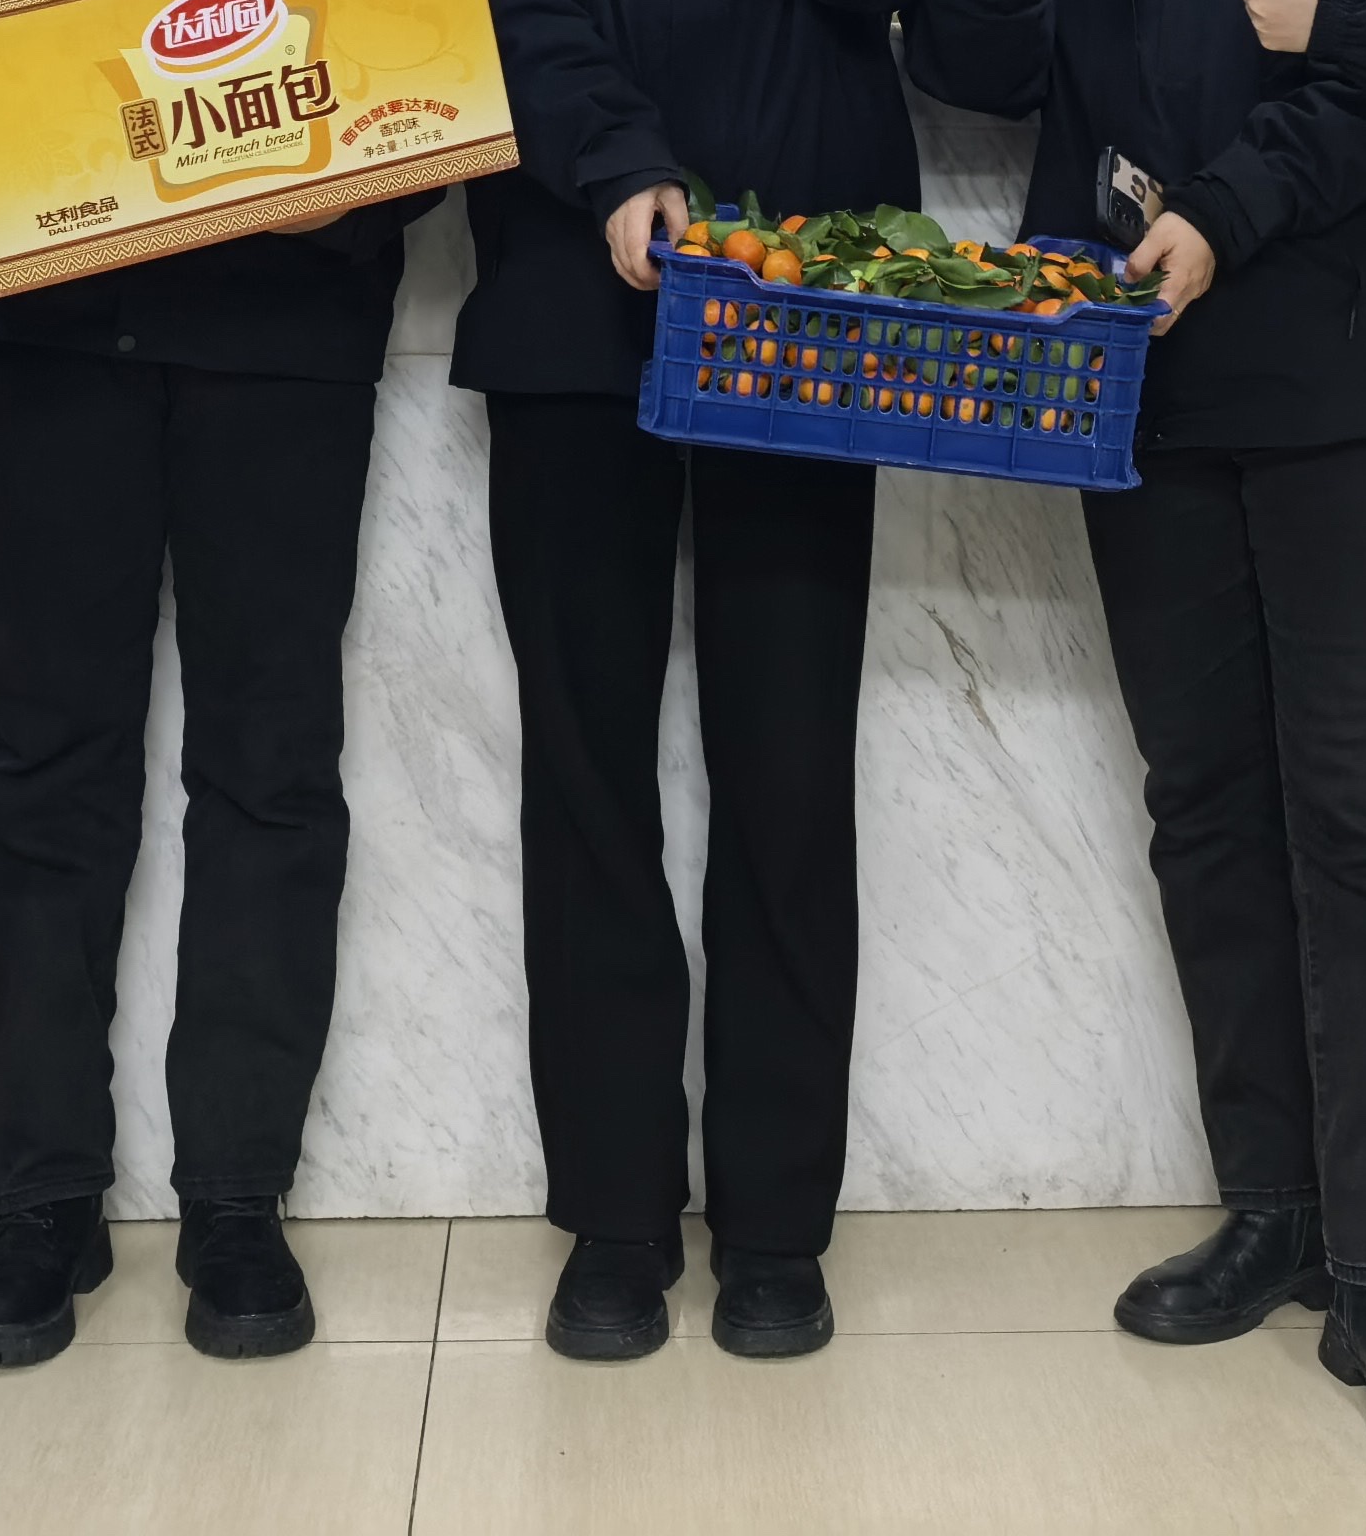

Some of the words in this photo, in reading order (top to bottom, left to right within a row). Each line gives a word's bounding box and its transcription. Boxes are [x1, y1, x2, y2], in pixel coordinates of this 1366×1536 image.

[171, 59, 341, 149] 小面包
[339, 98, 459, 146] 面包就要达利园
[129, 106, 160, 154] 法式
[176, 149, 209, 169] Mini
[213, 136, 260, 160] French
[265, 127, 304, 147] bread
[379, 117, 421, 137] 香奶味
[36, 196, 119, 229] 达利食品
[48, 225, 73, 236] DALI
[76, 215, 112, 230] FOODS
